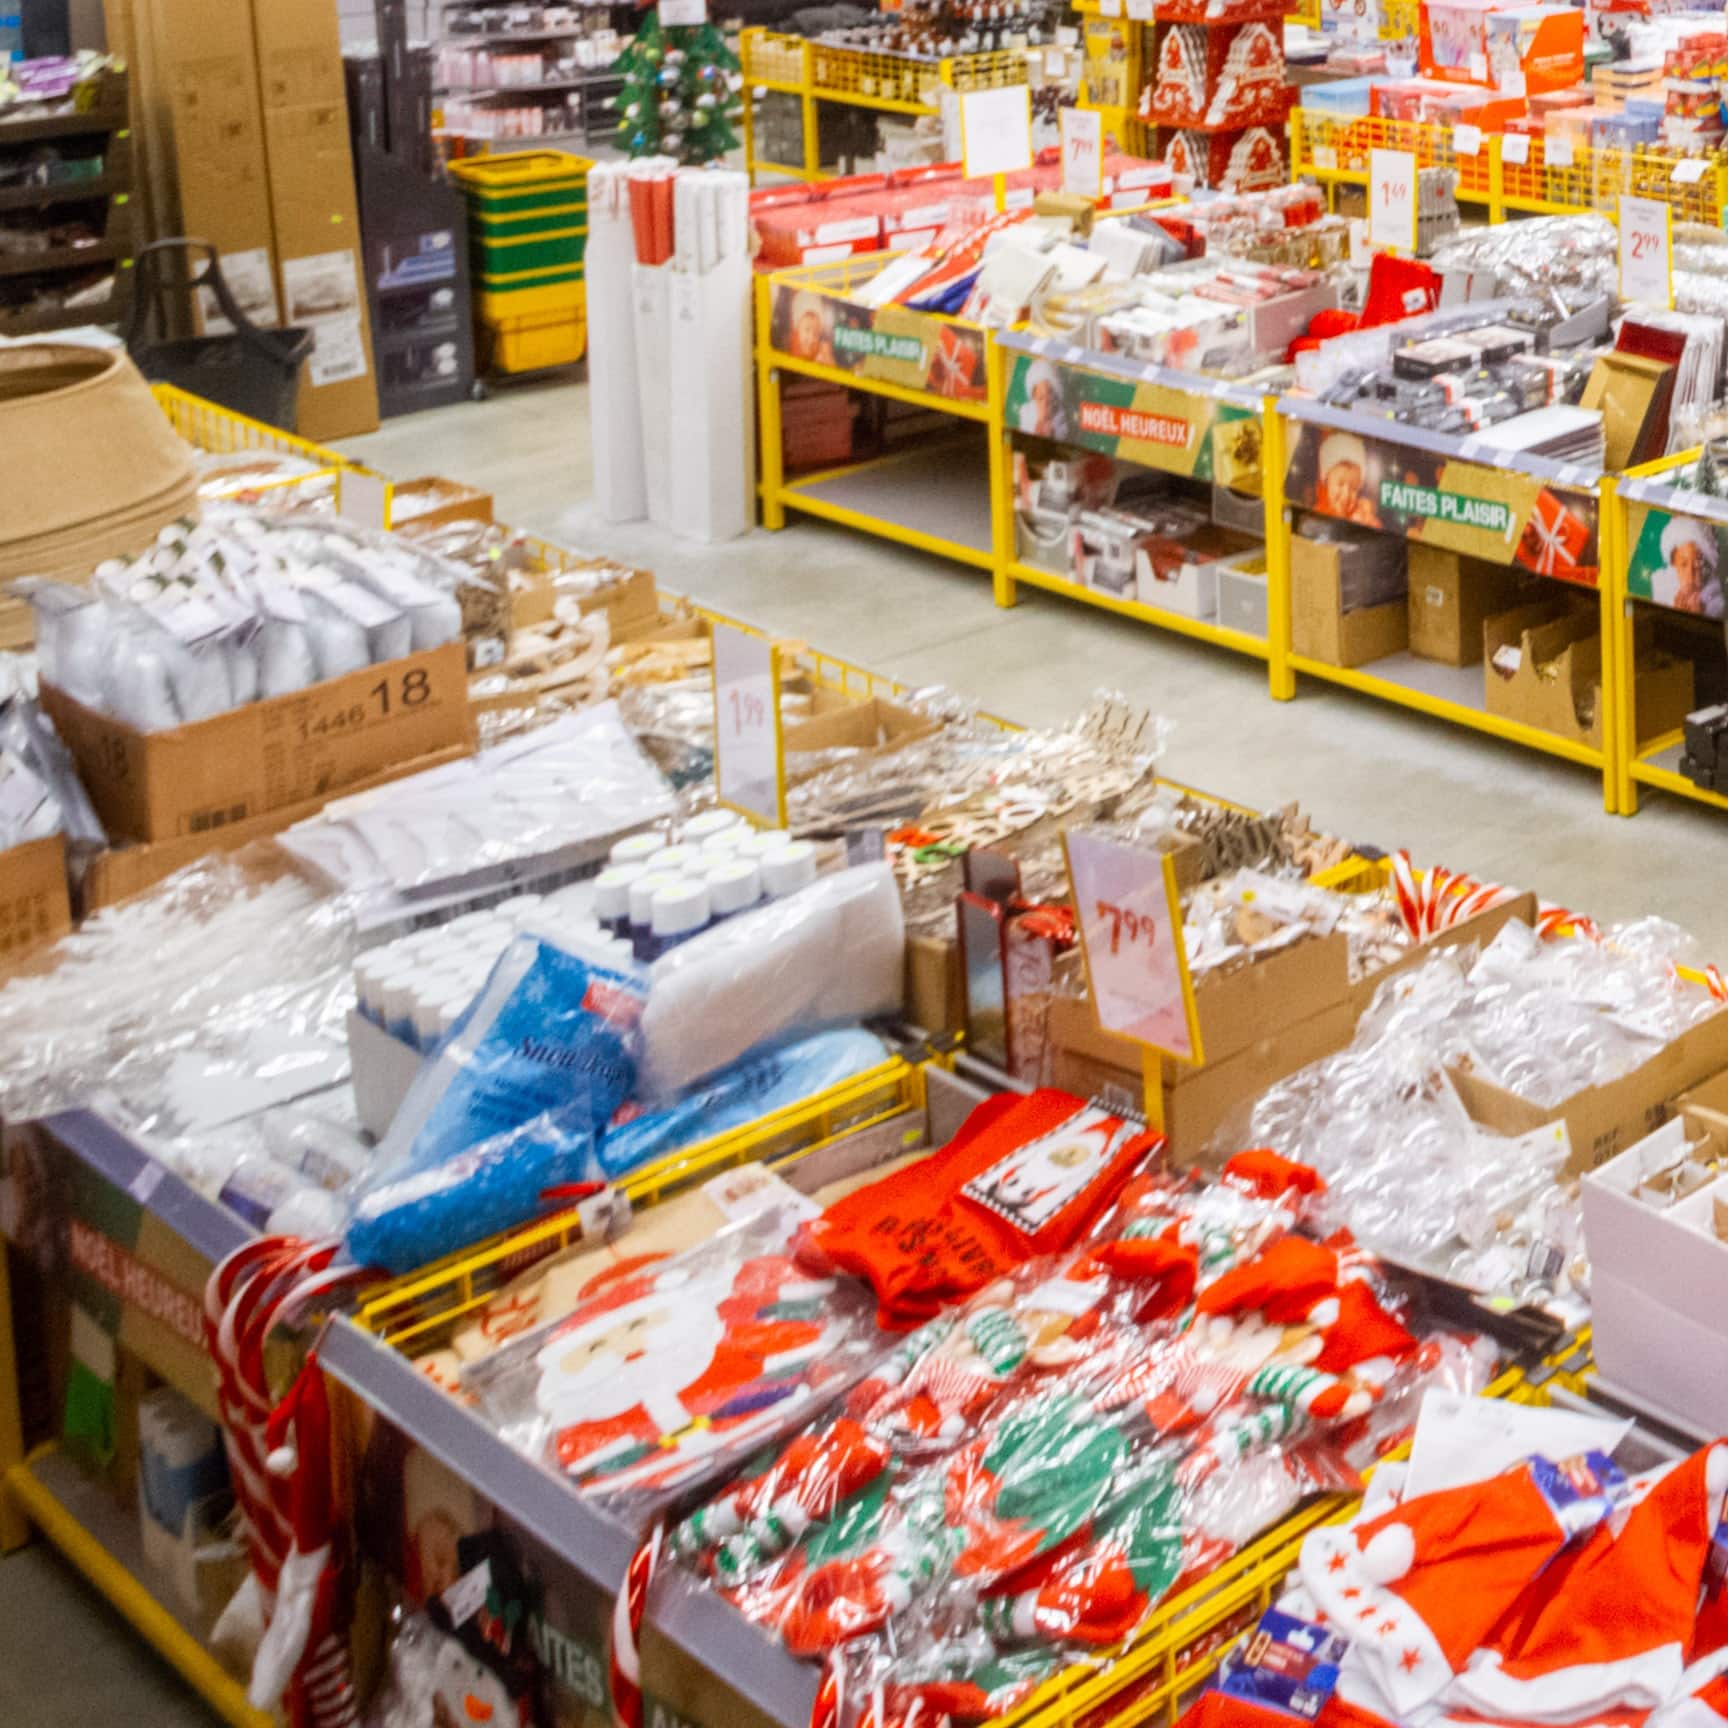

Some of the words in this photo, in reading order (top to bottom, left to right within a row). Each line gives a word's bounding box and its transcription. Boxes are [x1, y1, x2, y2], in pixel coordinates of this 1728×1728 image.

[1631, 231, 1661, 259] 299
[834, 327, 875, 353] FAITES
[876, 332, 920, 361] PLAISIR
[1081, 403, 1118, 432] NOËL
[1120, 413, 1187, 446] HEUREUX
[1381, 481, 1438, 515] FAITES
[1440, 493, 1508, 530] PLAISIR
[299, 703, 366, 739] 1446
[370, 668, 431, 715] 18
[1096, 898, 1157, 956] 799
